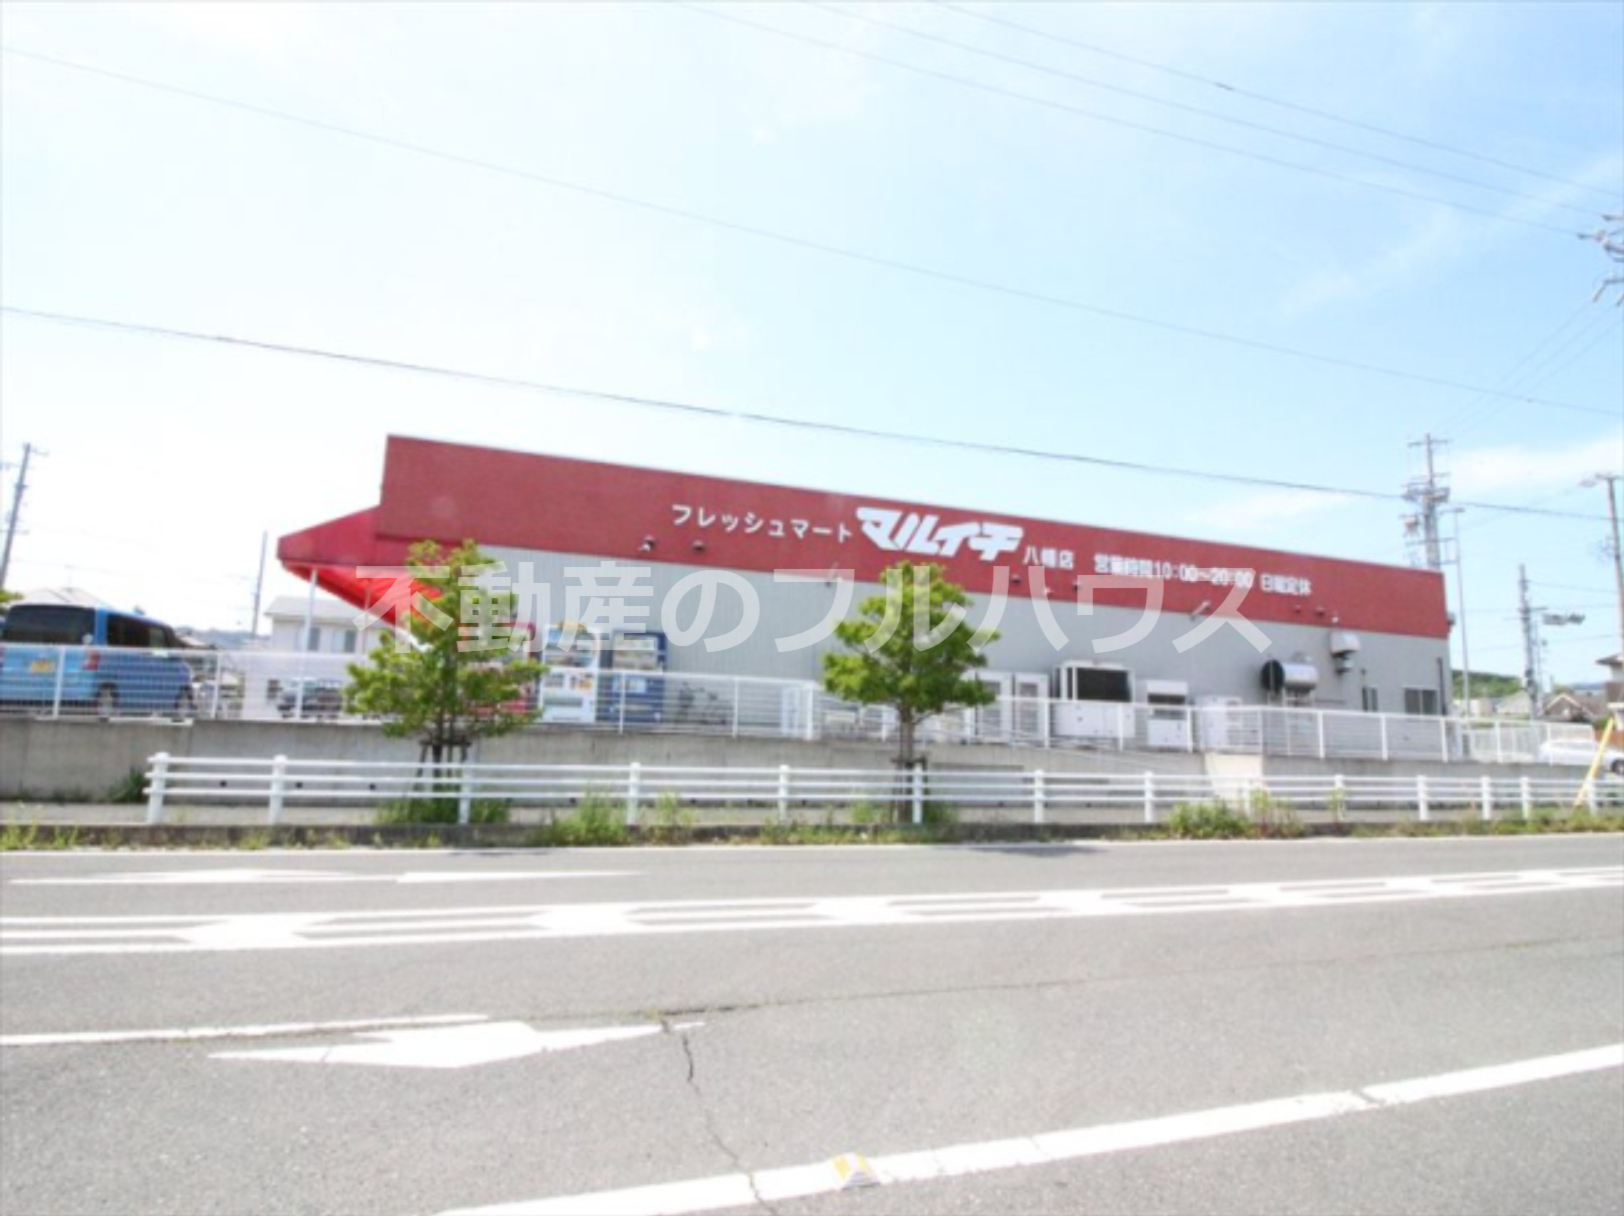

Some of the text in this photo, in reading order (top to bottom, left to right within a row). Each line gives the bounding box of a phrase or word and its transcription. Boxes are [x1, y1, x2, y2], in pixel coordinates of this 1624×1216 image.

[671, 504, 853, 543] フレッシュマート
[856, 506, 1024, 561] マルイチ
